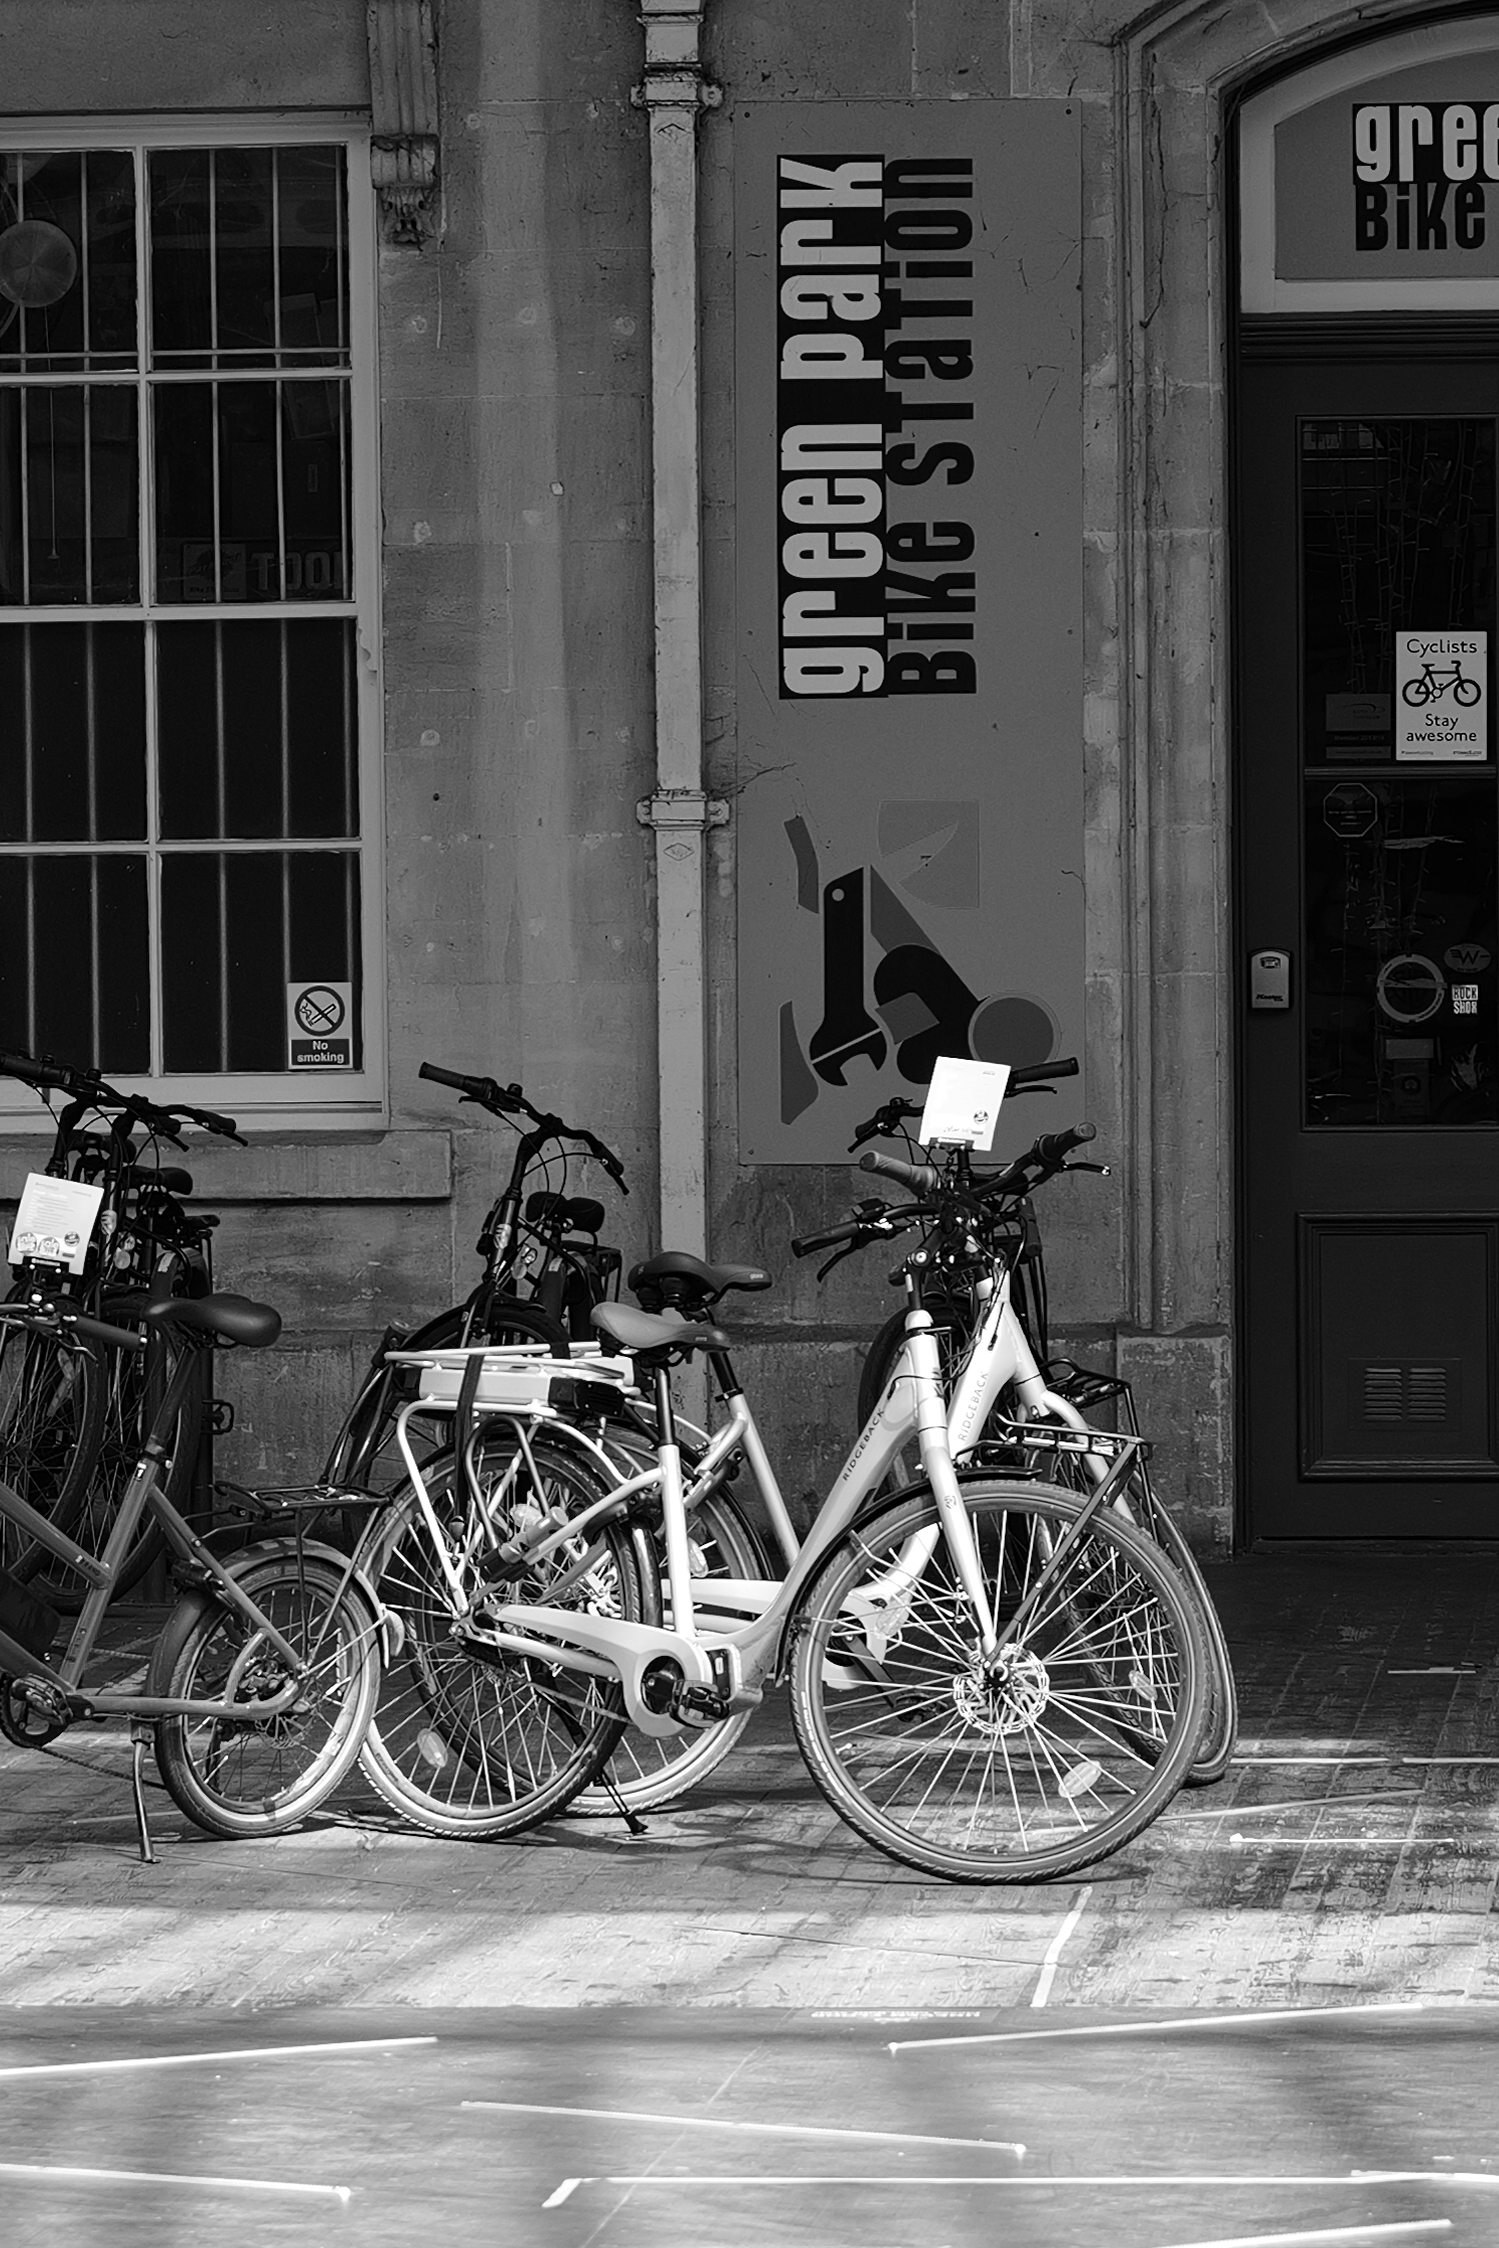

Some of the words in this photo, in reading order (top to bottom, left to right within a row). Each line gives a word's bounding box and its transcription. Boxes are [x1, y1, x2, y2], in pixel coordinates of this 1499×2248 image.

[780, 157, 884, 380] park
[780, 423, 885, 694] green
[1406, 638, 1478, 658] Cyclists
[1425, 713, 1459, 731] Stay
[1406, 732, 1478, 742] awesome
[1453, 986, 1477, 1000] ROCK
[1453, 1001, 1478, 1014] SHOX
[312, 1040, 329, 1051] No
[297, 1052, 345, 1064] smoking
[957, 1371, 989, 1442] RIDGEBACK
[841, 1407, 886, 1482] RIDGEBACK
